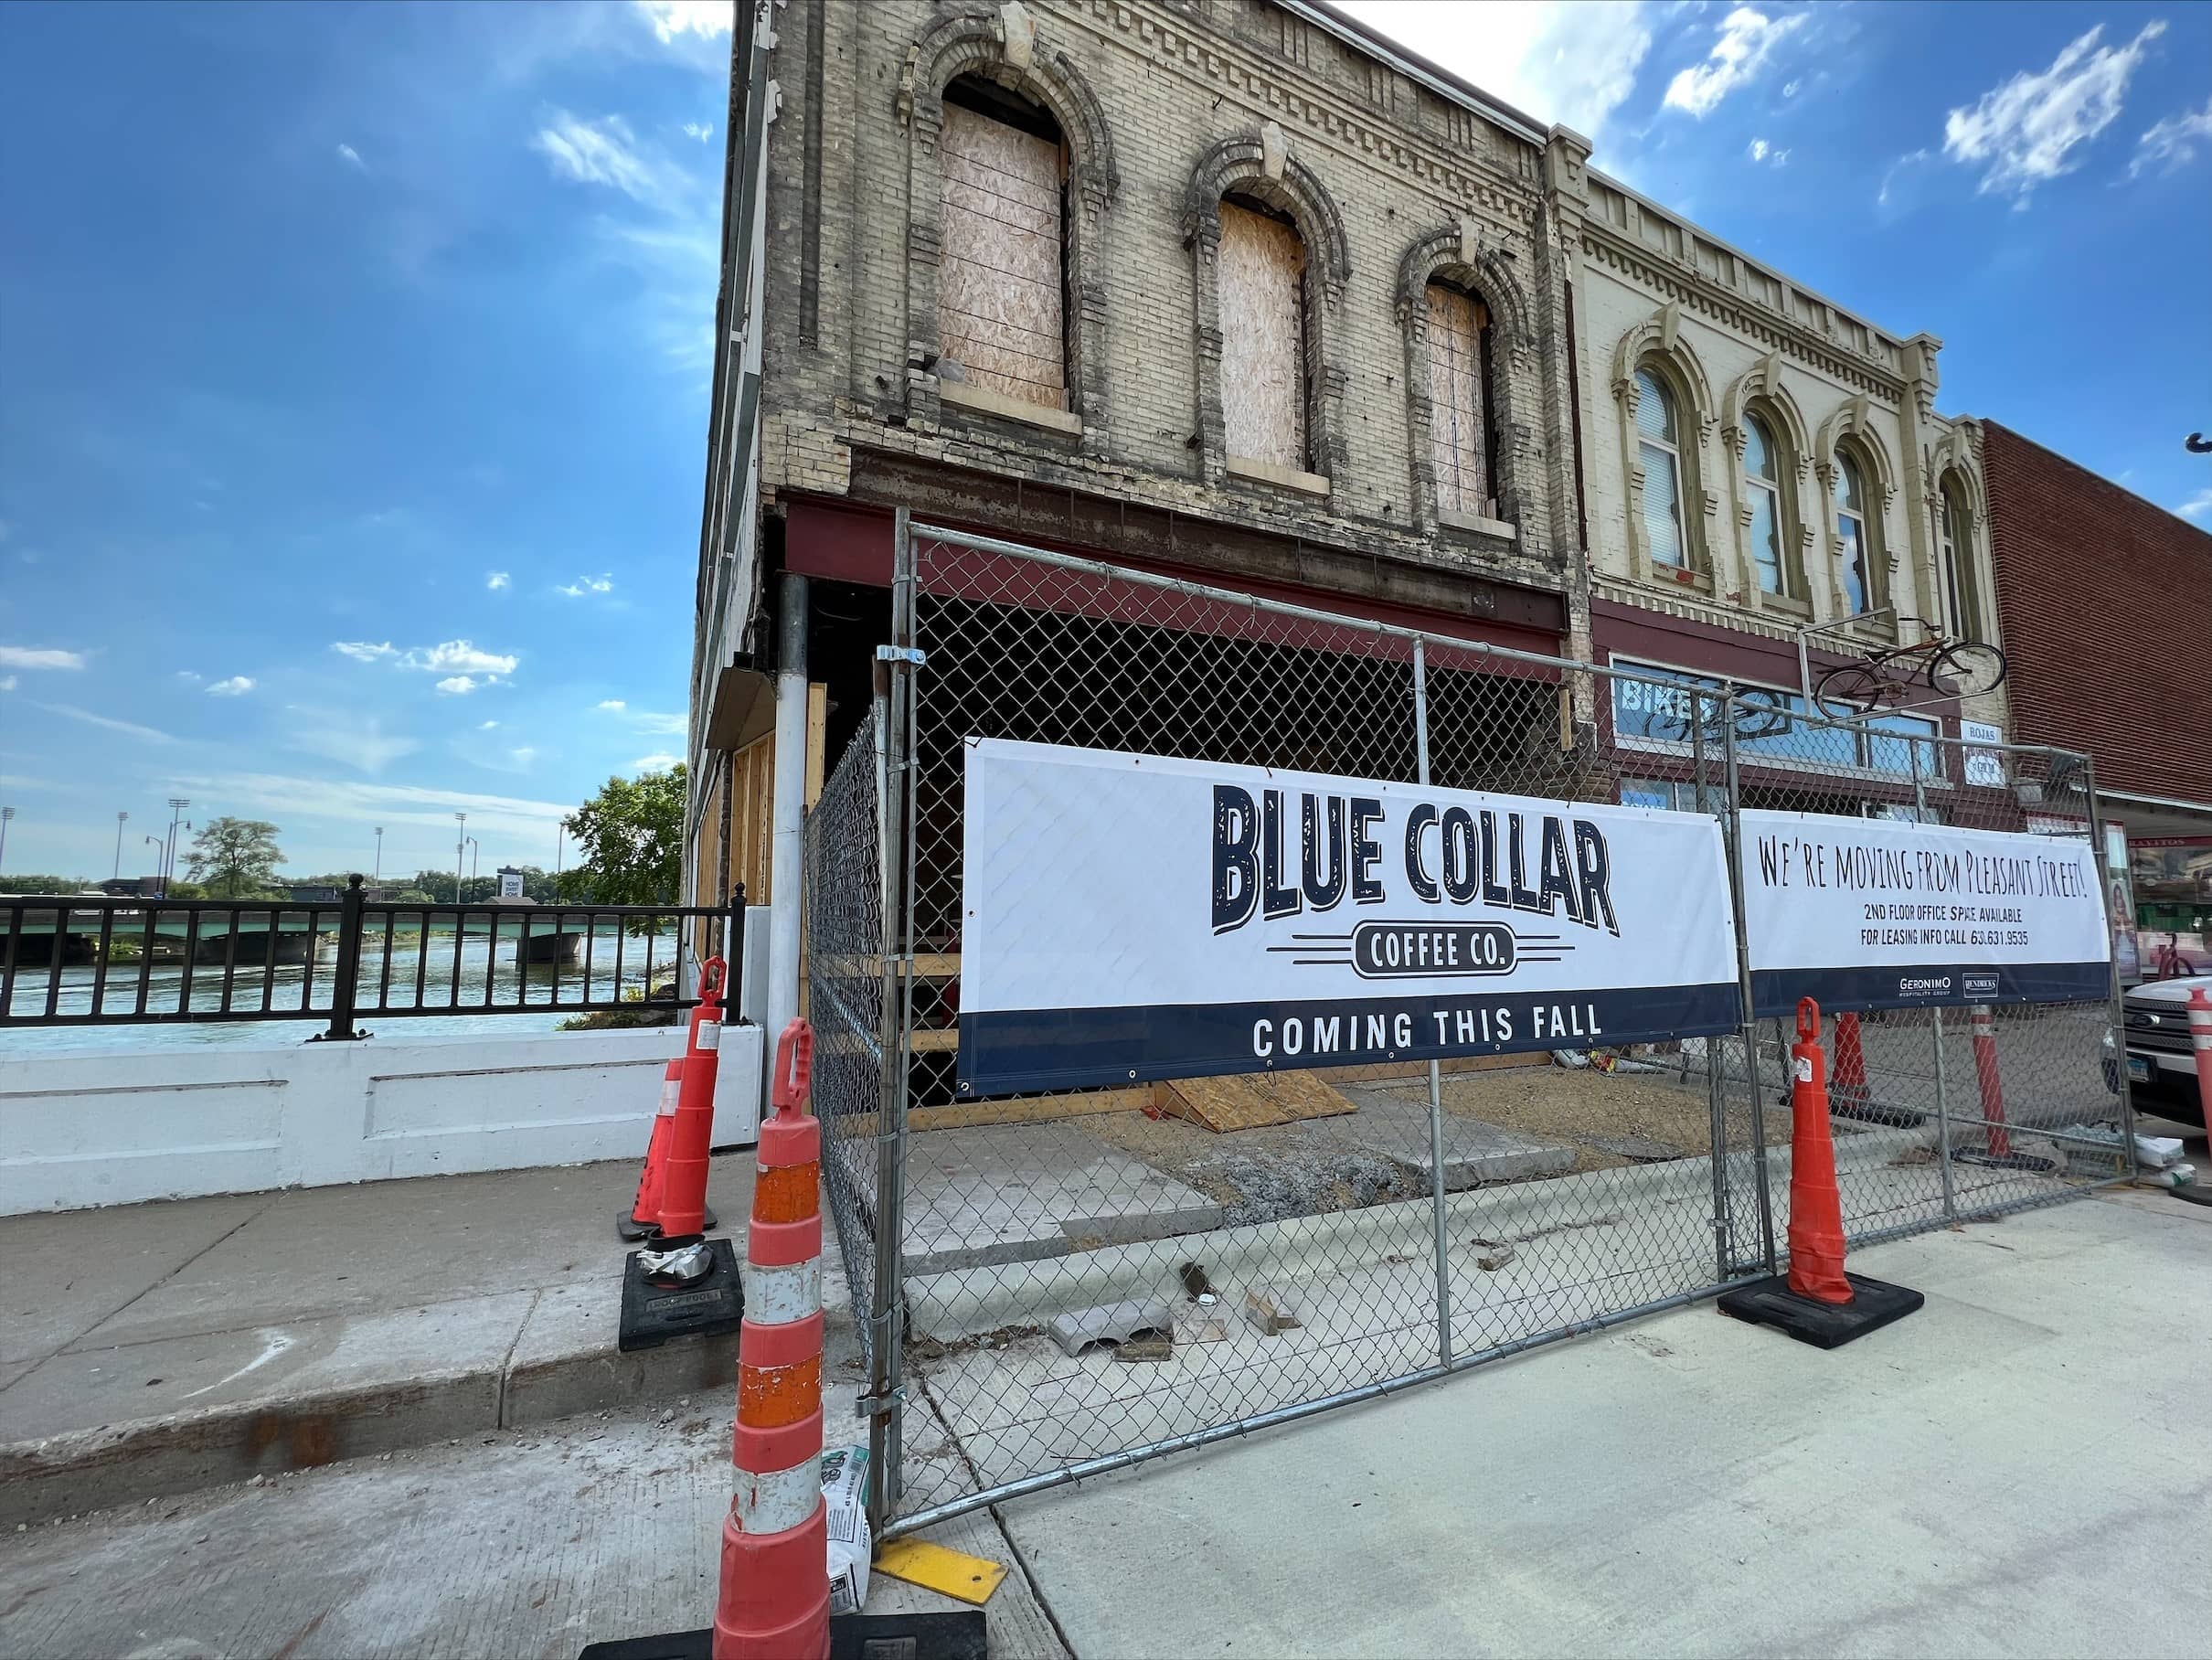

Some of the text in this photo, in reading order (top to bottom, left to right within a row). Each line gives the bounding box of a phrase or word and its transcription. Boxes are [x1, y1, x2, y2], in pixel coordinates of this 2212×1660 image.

[1969, 727, 1996, 741] ROJAS
[1212, 784, 1621, 938] BLUE COLLAR
[1759, 835, 2088, 899] WE'RE MOVING FROM PLEASANT STREET!
[1864, 903, 1887, 920] 2ND
[1888, 904, 1915, 921] FLOOR
[1917, 905, 1947, 920] OFFICE
[1979, 907, 2023, 923] AVAILABLE
[1370, 931, 1506, 967] COFFEE CO.
[1861, 929, 1879, 945] FOR
[1881, 929, 1918, 945] LEASING
[1920, 929, 1942, 945] INFO
[1944, 929, 1967, 945] CALL
[1899, 976, 1951, 990] GERONIMO
[1253, 1004, 1602, 1057] COMING THIS FALL
